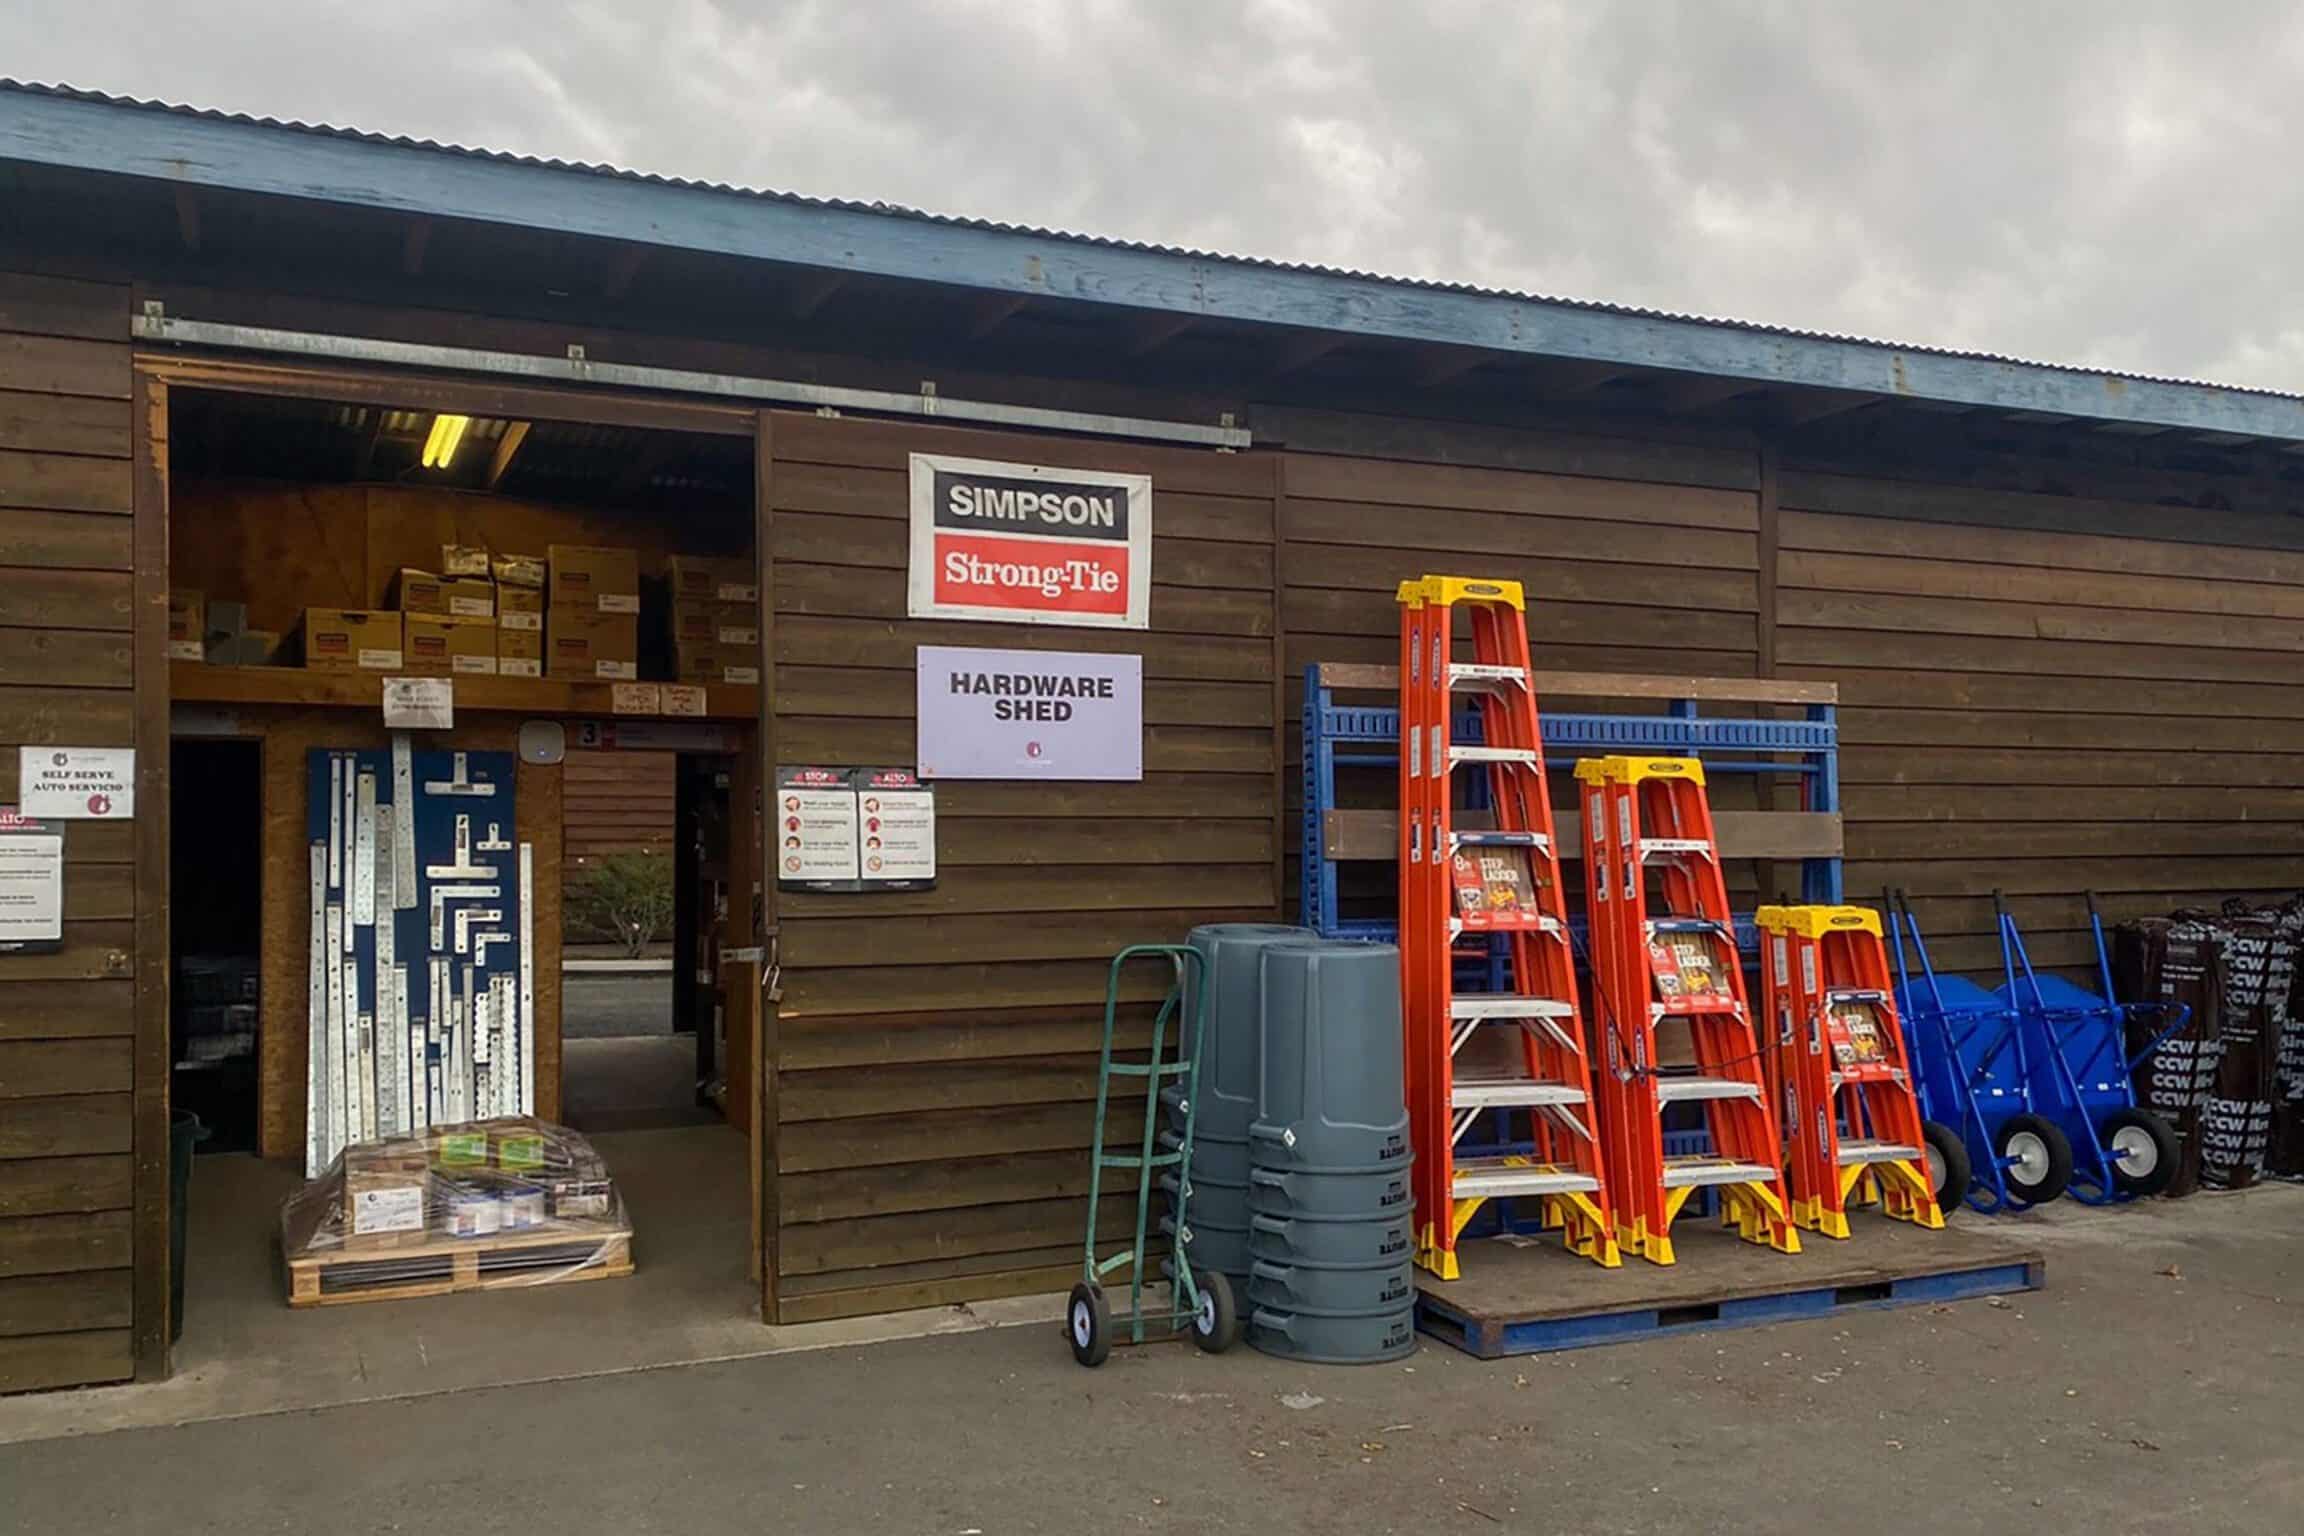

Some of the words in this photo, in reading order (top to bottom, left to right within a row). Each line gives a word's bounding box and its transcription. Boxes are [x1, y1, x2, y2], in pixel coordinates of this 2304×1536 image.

[949, 485, 1115, 527] SIMPSON
[945, 551, 1121, 598] Strong-Tie
[950, 671, 1114, 698] HARDWARE
[994, 698, 1073, 721] SHED
[583, 723, 595, 743] 3
[41, 770, 71, 779] SELF
[74, 770, 114, 779] SERVE
[804, 771, 829, 781] STOP
[882, 773, 907, 783] ALTO
[33, 783, 66, 791] AUTO
[68, 783, 123, 792] SERVICIO
[2157, 1039, 2196, 1055] CCW
[2153, 1056, 2194, 1072] CCW
[2151, 1073, 2192, 1089] CCW
[2150, 1091, 2190, 1107] CCW
